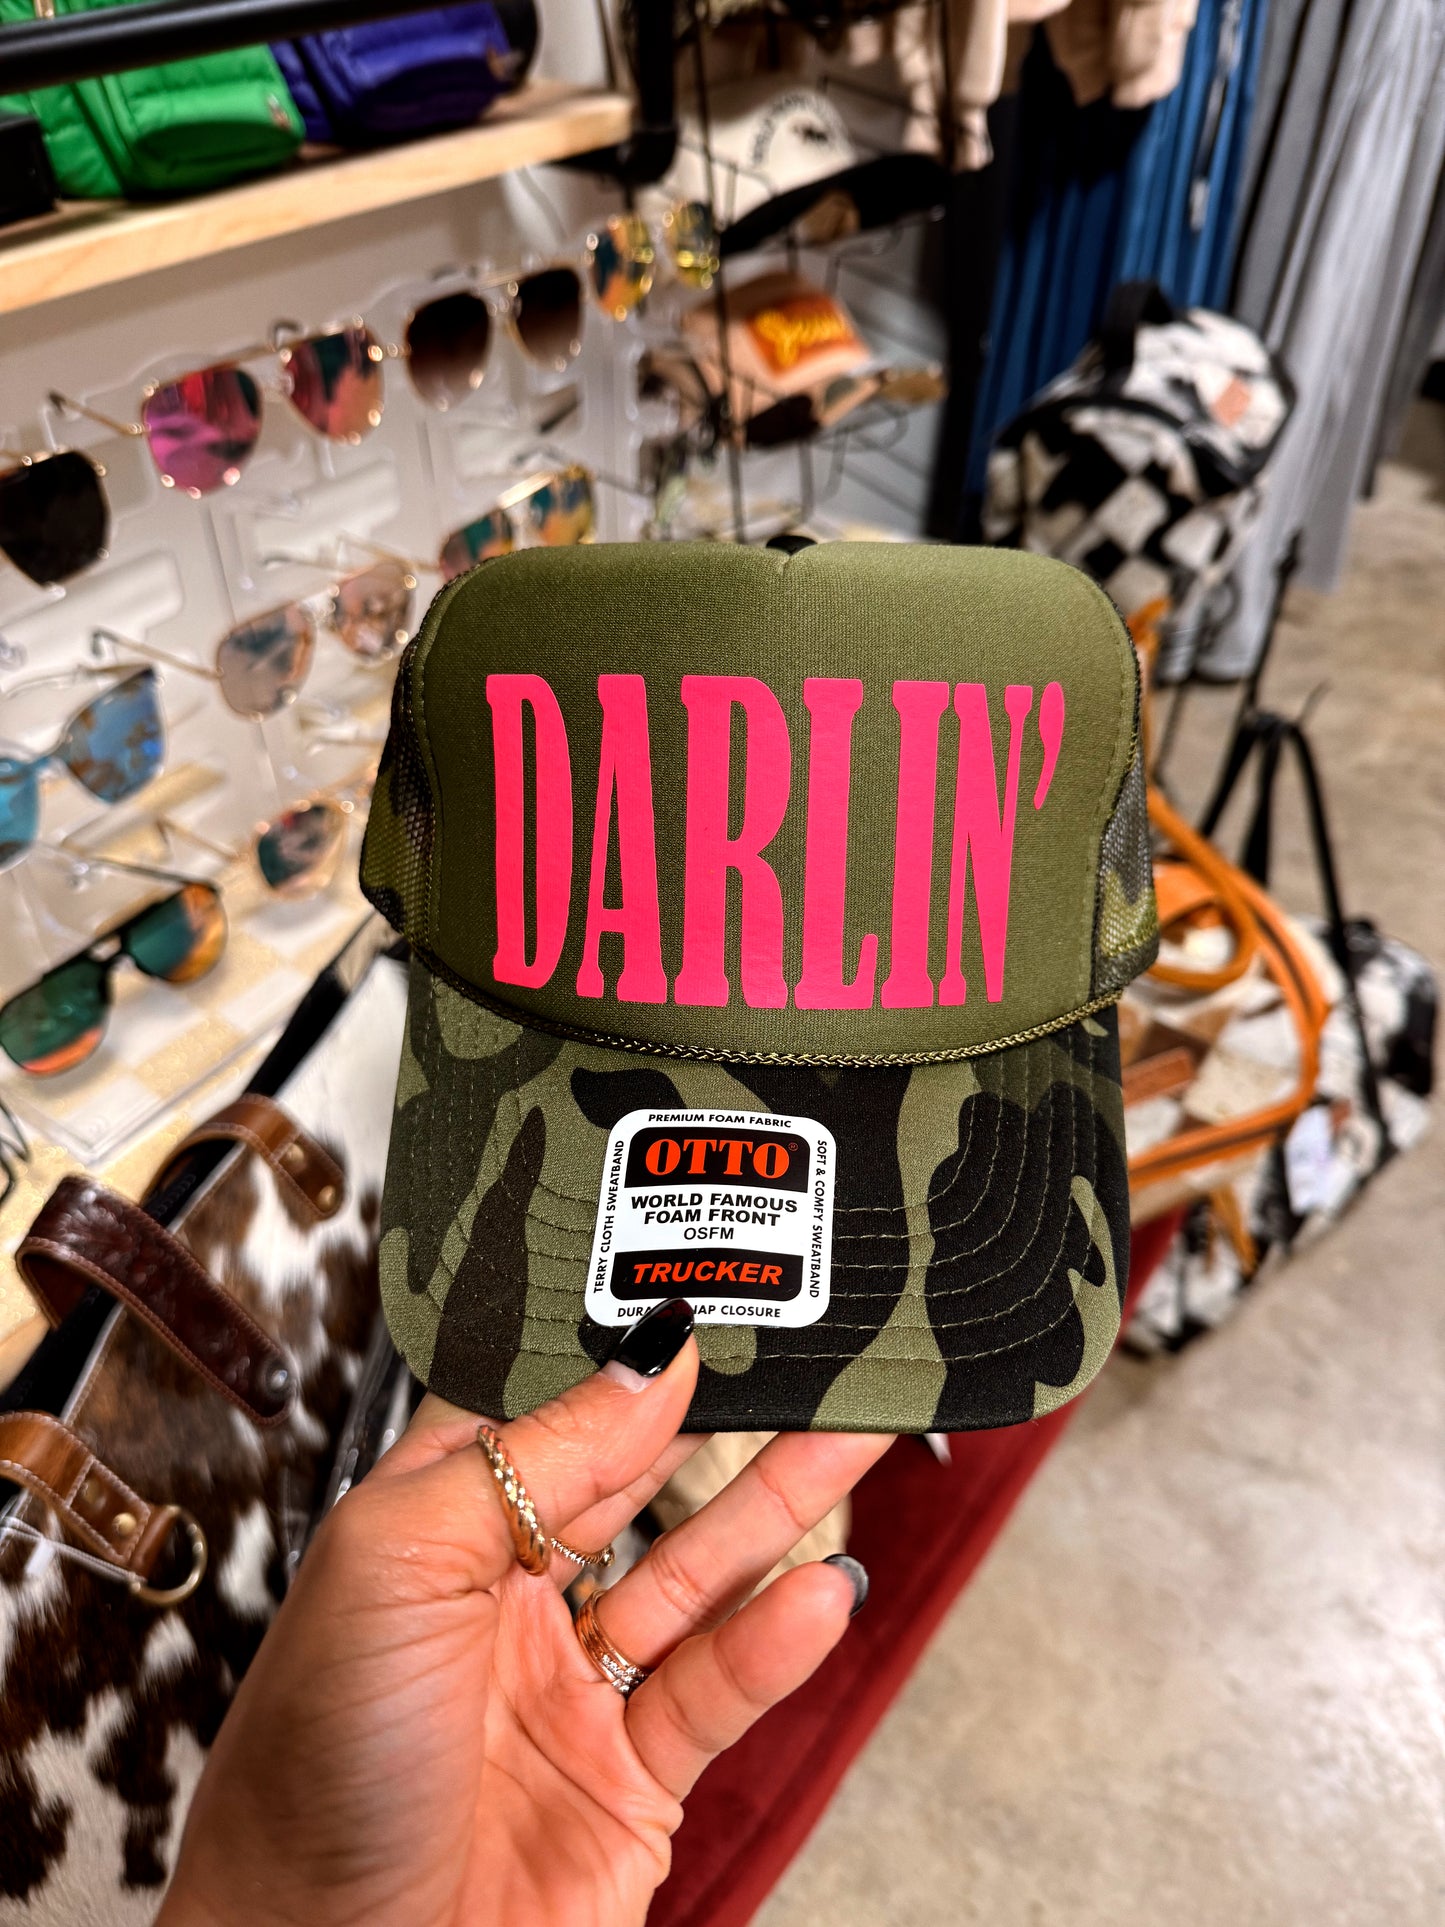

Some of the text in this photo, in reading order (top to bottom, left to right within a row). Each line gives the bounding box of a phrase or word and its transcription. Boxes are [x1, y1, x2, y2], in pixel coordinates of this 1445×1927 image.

[486, 674, 1065, 1010] DARLIN'
[648, 1114, 792, 1127] PREMIUM FOAM FABRIC
[645, 1139, 789, 1179] OTTO
[631, 1193, 798, 1213] WORLD FAMOUS
[594, 1140, 624, 1293] TERRY CLOTH SWEATBAND
[644, 1209, 780, 1226] FOAM FRONT
[809, 1140, 827, 1298] SOFT & COMFY SWEATBAND
[683, 1227, 734, 1240] OSFM
[633, 1261, 783, 1285] TRUCKER
[721, 1306, 781, 1318] CLOSURE
